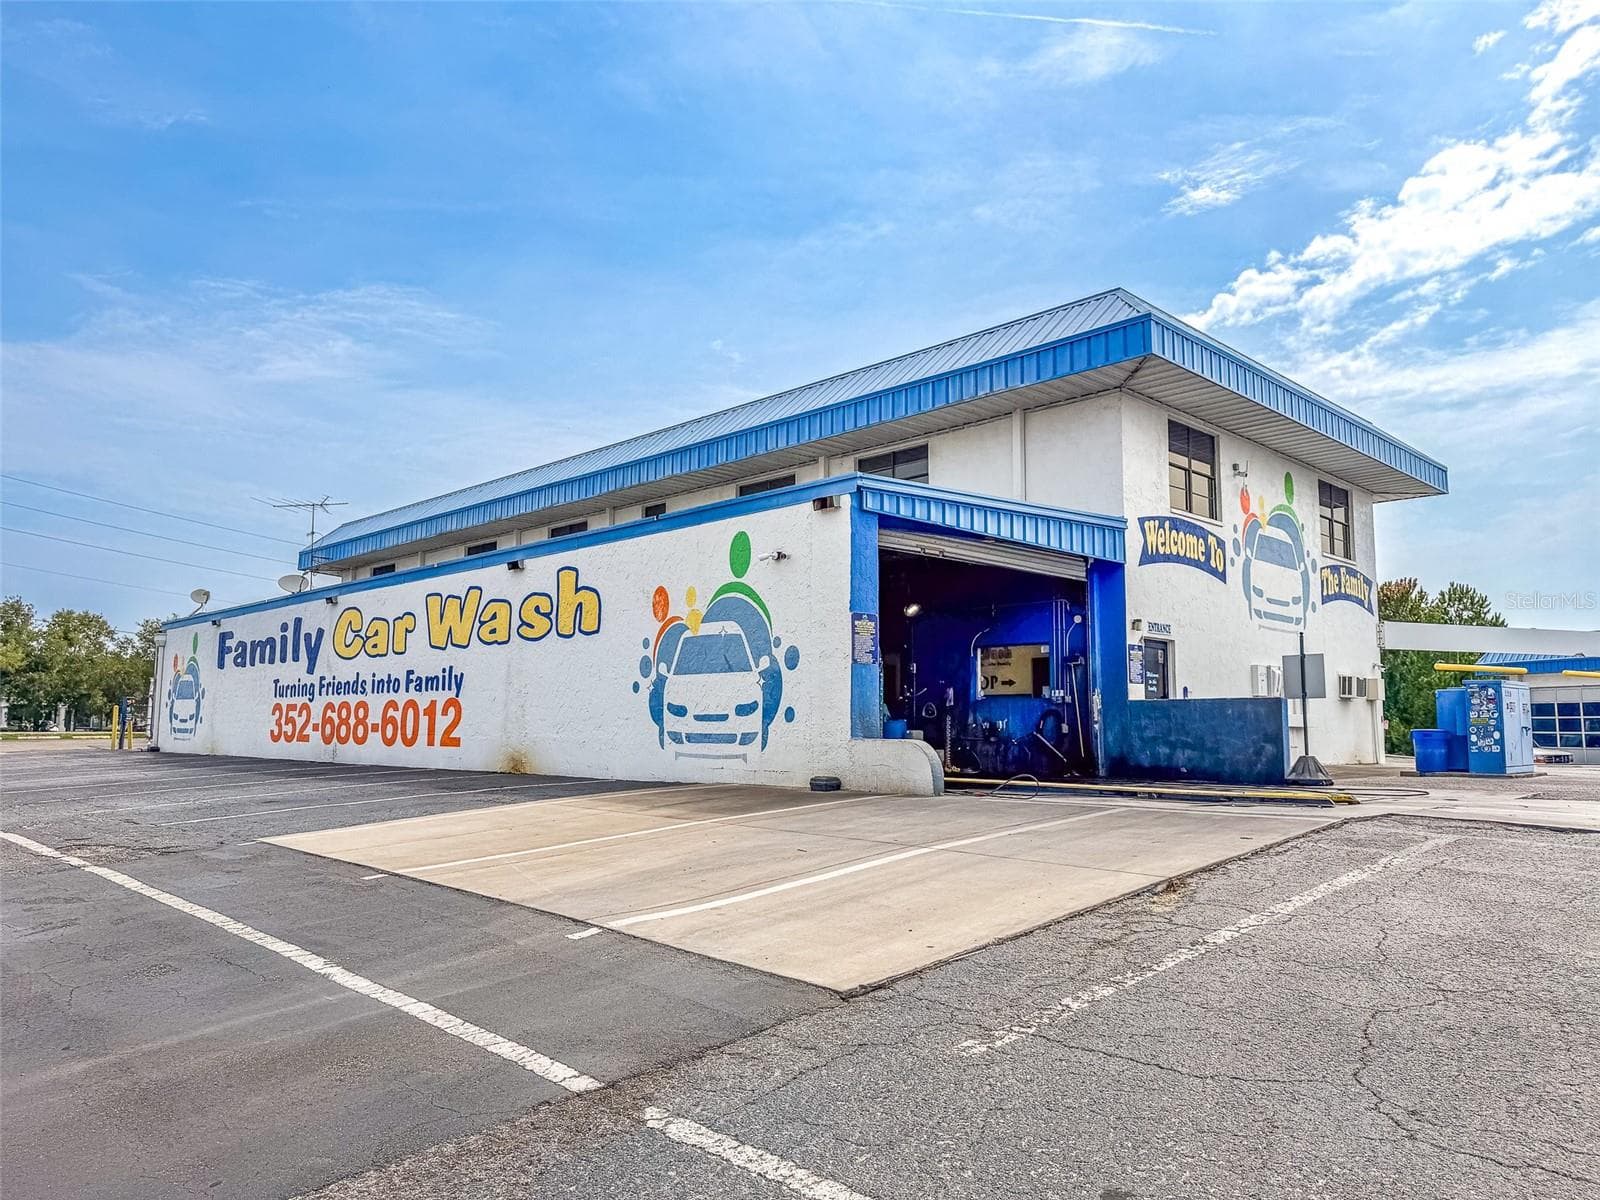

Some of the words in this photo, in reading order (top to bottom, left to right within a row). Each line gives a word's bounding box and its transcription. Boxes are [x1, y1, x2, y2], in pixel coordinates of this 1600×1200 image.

[1144, 519, 1206, 563] Welcome
[1208, 533, 1225, 573] To
[1321, 567, 1339, 596] The
[1340, 567, 1370, 609] Family
[217, 616, 325, 675] Family
[332, 606, 417, 661] Car
[425, 565, 602, 651] Wash
[1147, 621, 1172, 634] ENTRANCE
[272, 677, 316, 703] Turning
[371, 671, 401, 695] into
[405, 665, 465, 698] Family
[269, 697, 463, 748] 352-688-6012
